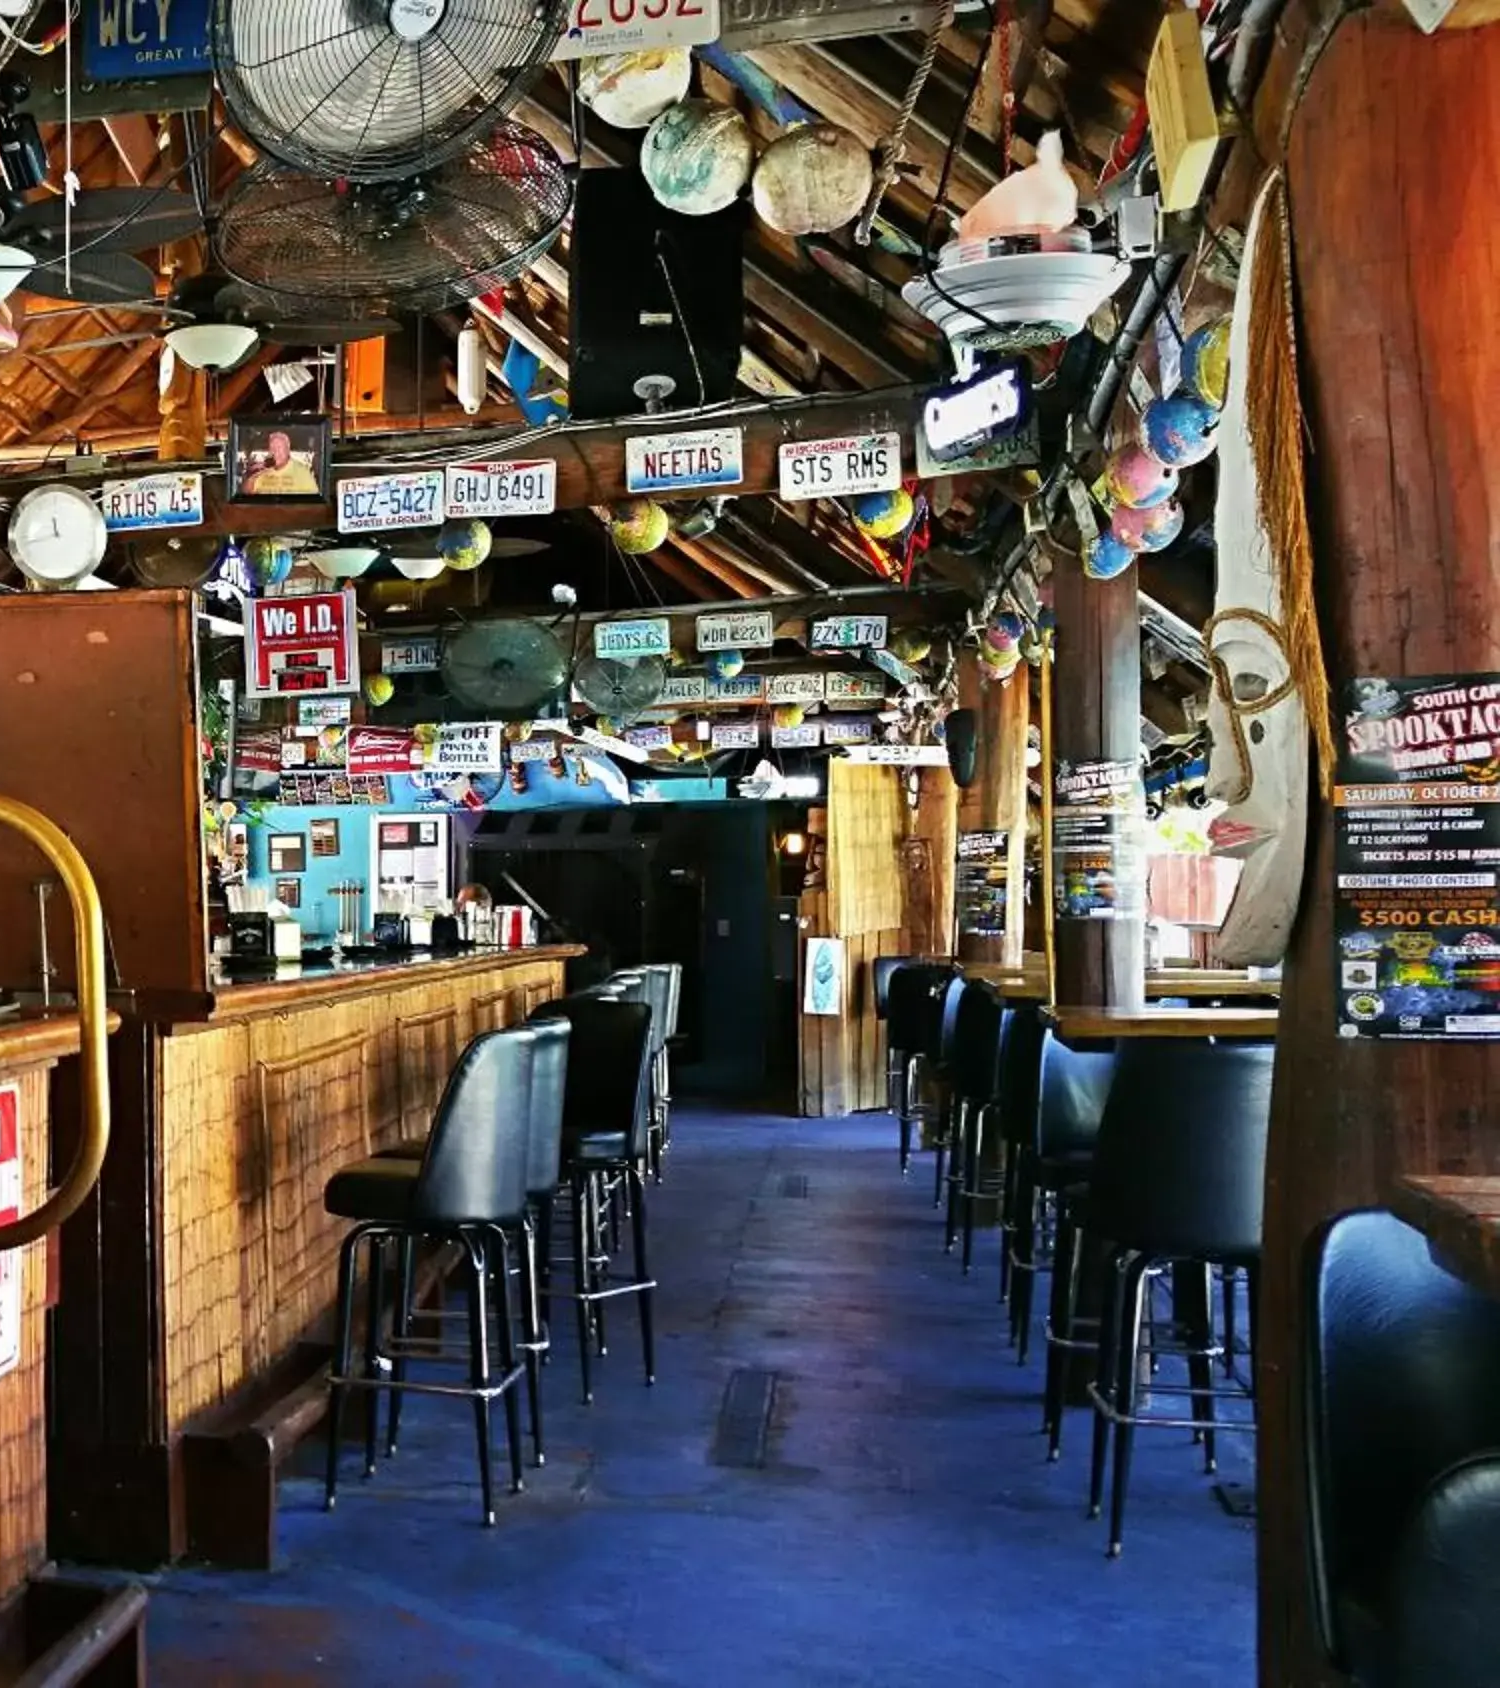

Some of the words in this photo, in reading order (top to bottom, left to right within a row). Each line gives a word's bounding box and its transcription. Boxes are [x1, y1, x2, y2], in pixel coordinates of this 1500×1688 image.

[135, 47, 183, 63] GREAT
[785, 440, 847, 457] WISCONSIN
[644, 447, 724, 479] NEETAS
[792, 456, 833, 485] STS
[847, 450, 889, 480] RMS
[454, 476, 490, 503] GHJ
[498, 473, 545, 501] 6491
[170, 490, 192, 514] 45
[262, 606, 297, 638] We
[303, 604, 338, 634] I.D.
[814, 624, 842, 644] ZZK
[1412, 688, 1467, 711] SOUTH
[461, 726, 493, 740] OFF
[1344, 787, 1417, 801] SATURDAY,
[1421, 785, 1490, 800] OCTOBER
[1403, 820, 1440, 831] SAMPLE
[1347, 835, 1359, 845] AT
[1362, 835, 1372, 844] 12
[1362, 851, 1405, 862] TICKETS
[1407, 850, 1432, 861] JUST
[1435, 849, 1456, 861] $15
[1343, 876, 1393, 887] COSTUME
[1395, 875, 1433, 886] PHOTO
[1360, 909, 1421, 927] $500
[1427, 909, 1497, 925] CASH
